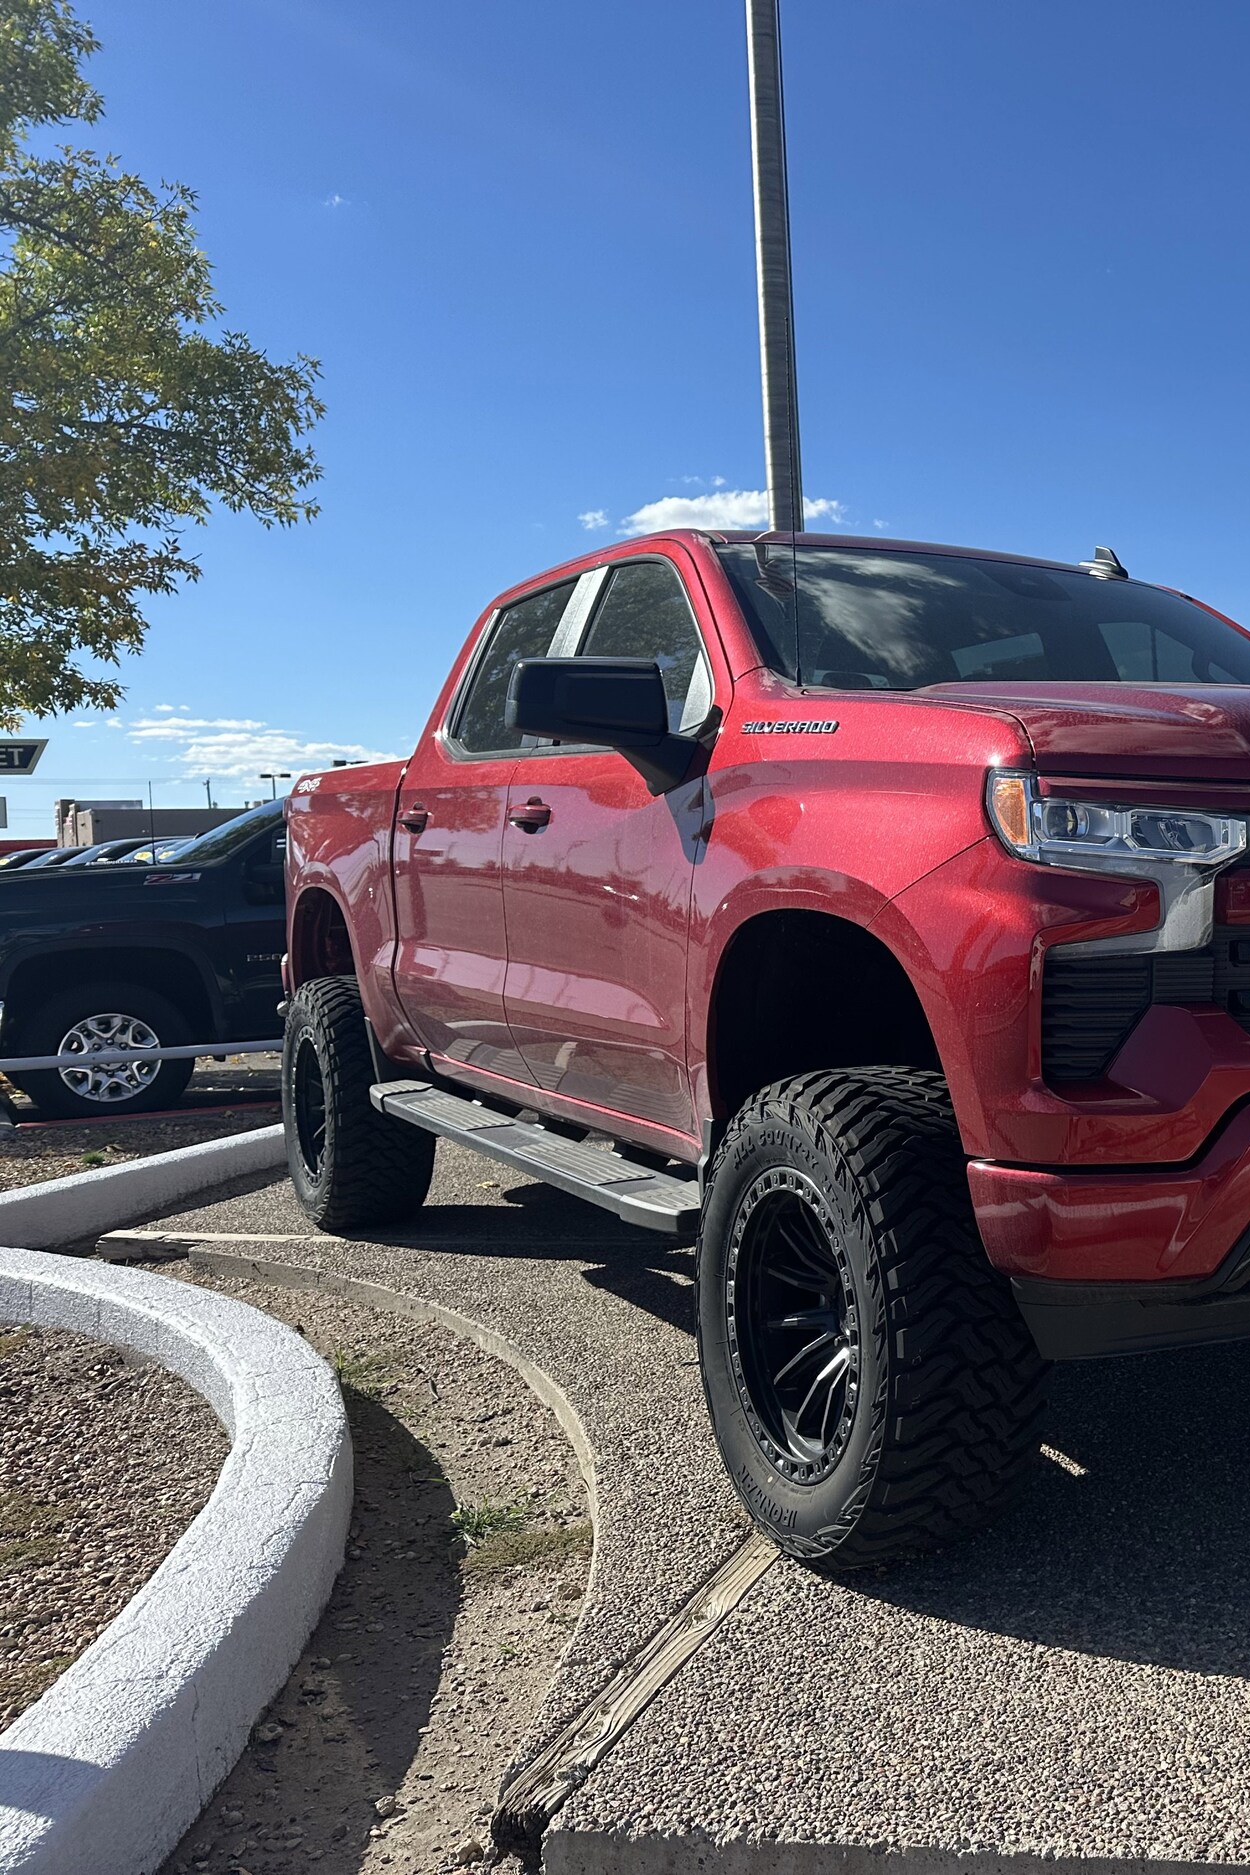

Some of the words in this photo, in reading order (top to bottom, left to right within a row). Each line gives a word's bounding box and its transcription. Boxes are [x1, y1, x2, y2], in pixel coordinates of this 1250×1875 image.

[741, 721, 840, 735] SILVERADO
[733, 1135, 757, 1170] ALL
[758, 1128, 820, 1170] COUNTRY
[738, 1464, 798, 1529] IRONMAN
